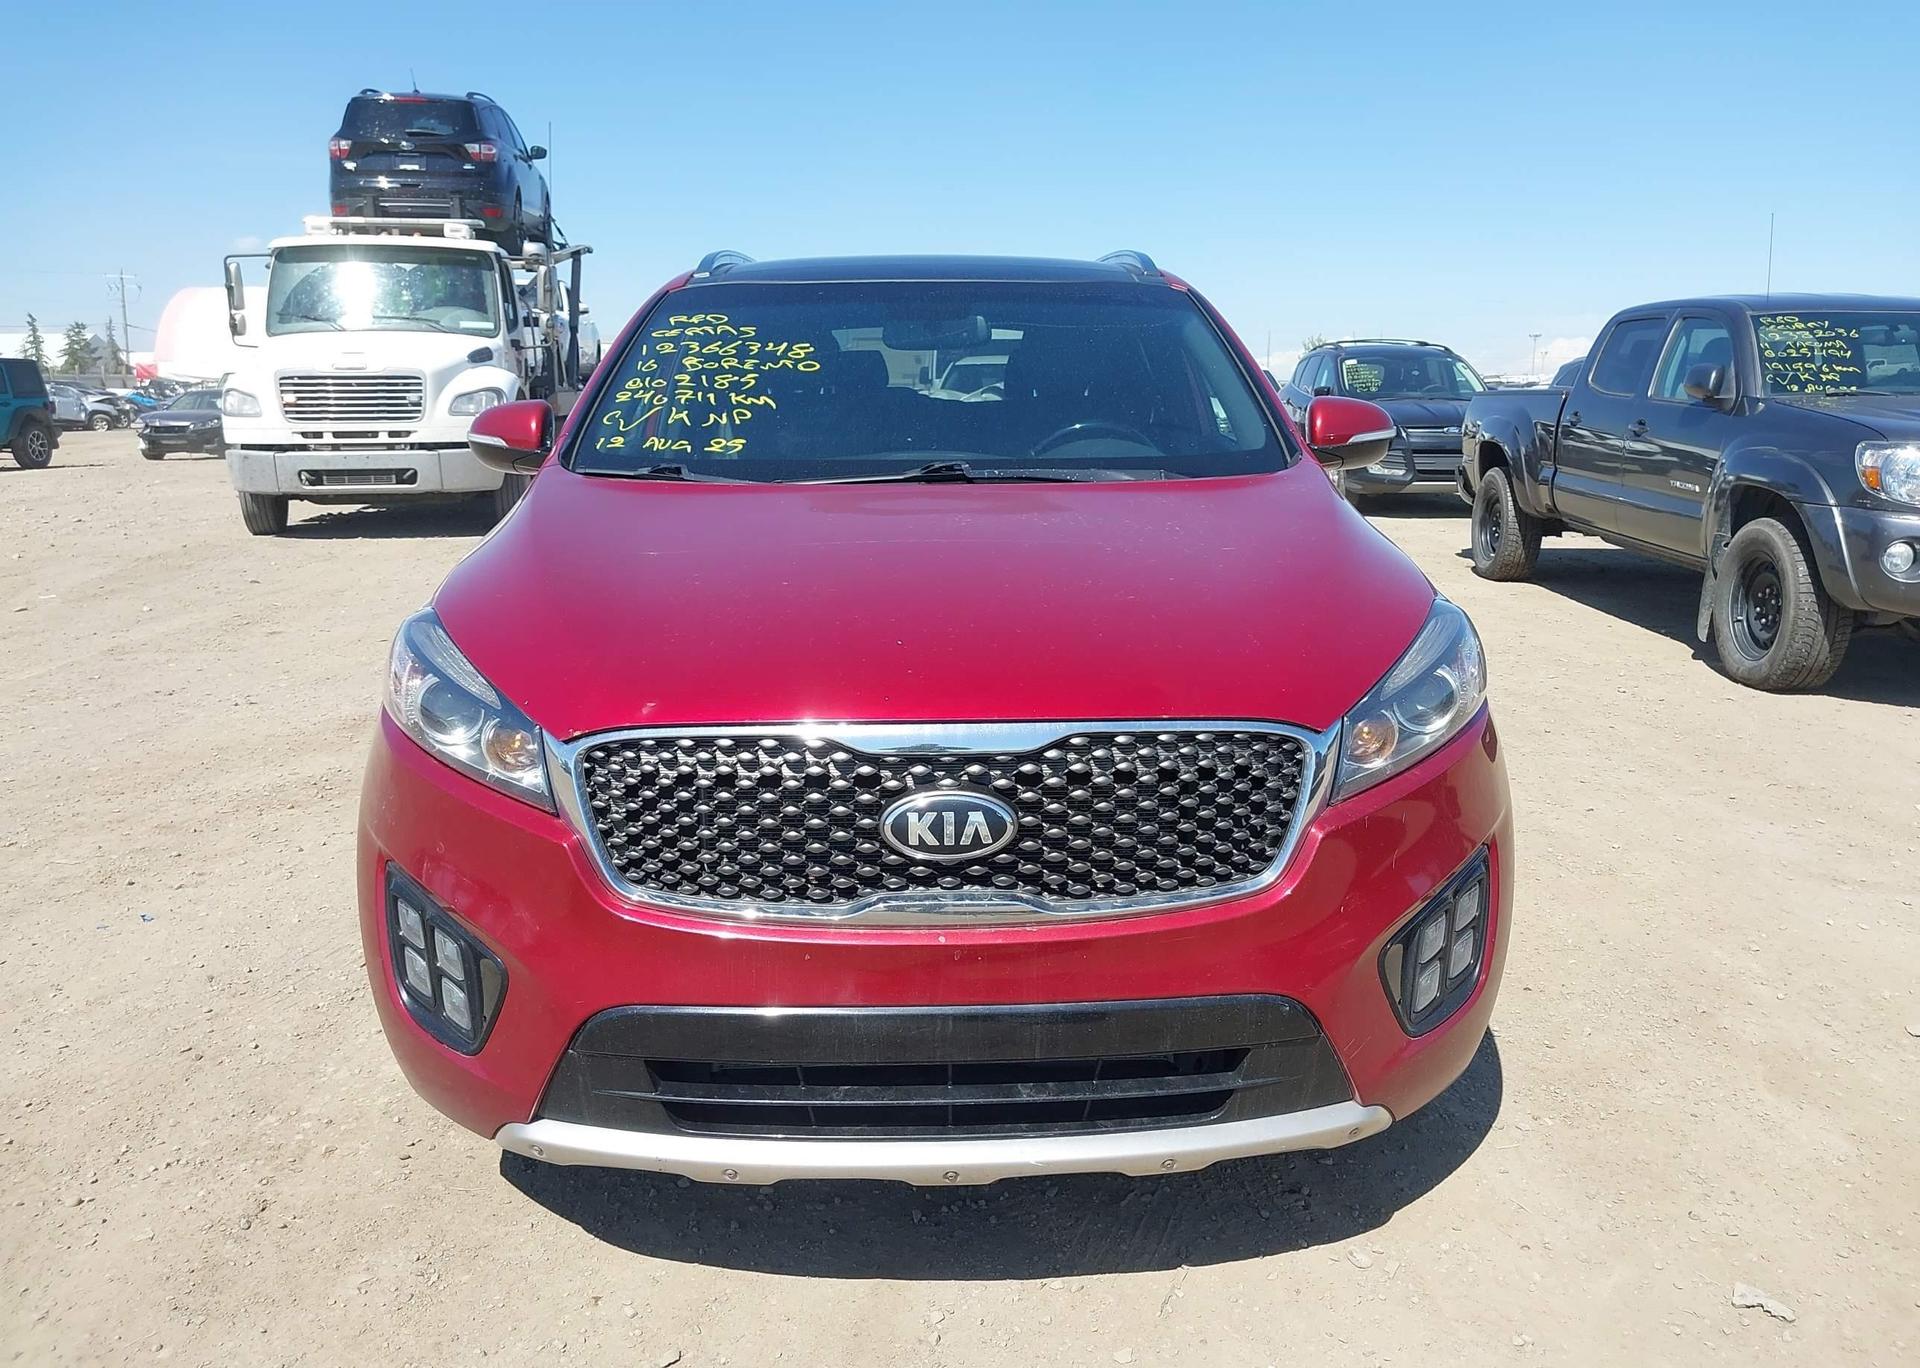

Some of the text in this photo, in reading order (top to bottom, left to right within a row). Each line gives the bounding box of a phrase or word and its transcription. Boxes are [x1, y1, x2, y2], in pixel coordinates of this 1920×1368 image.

[641, 340, 815, 358] 12366348
[637, 359, 658, 371] 16
[596, 436, 625, 450] 12
[642, 436, 692, 452] AUG
[906, 811, 993, 846] KIA
